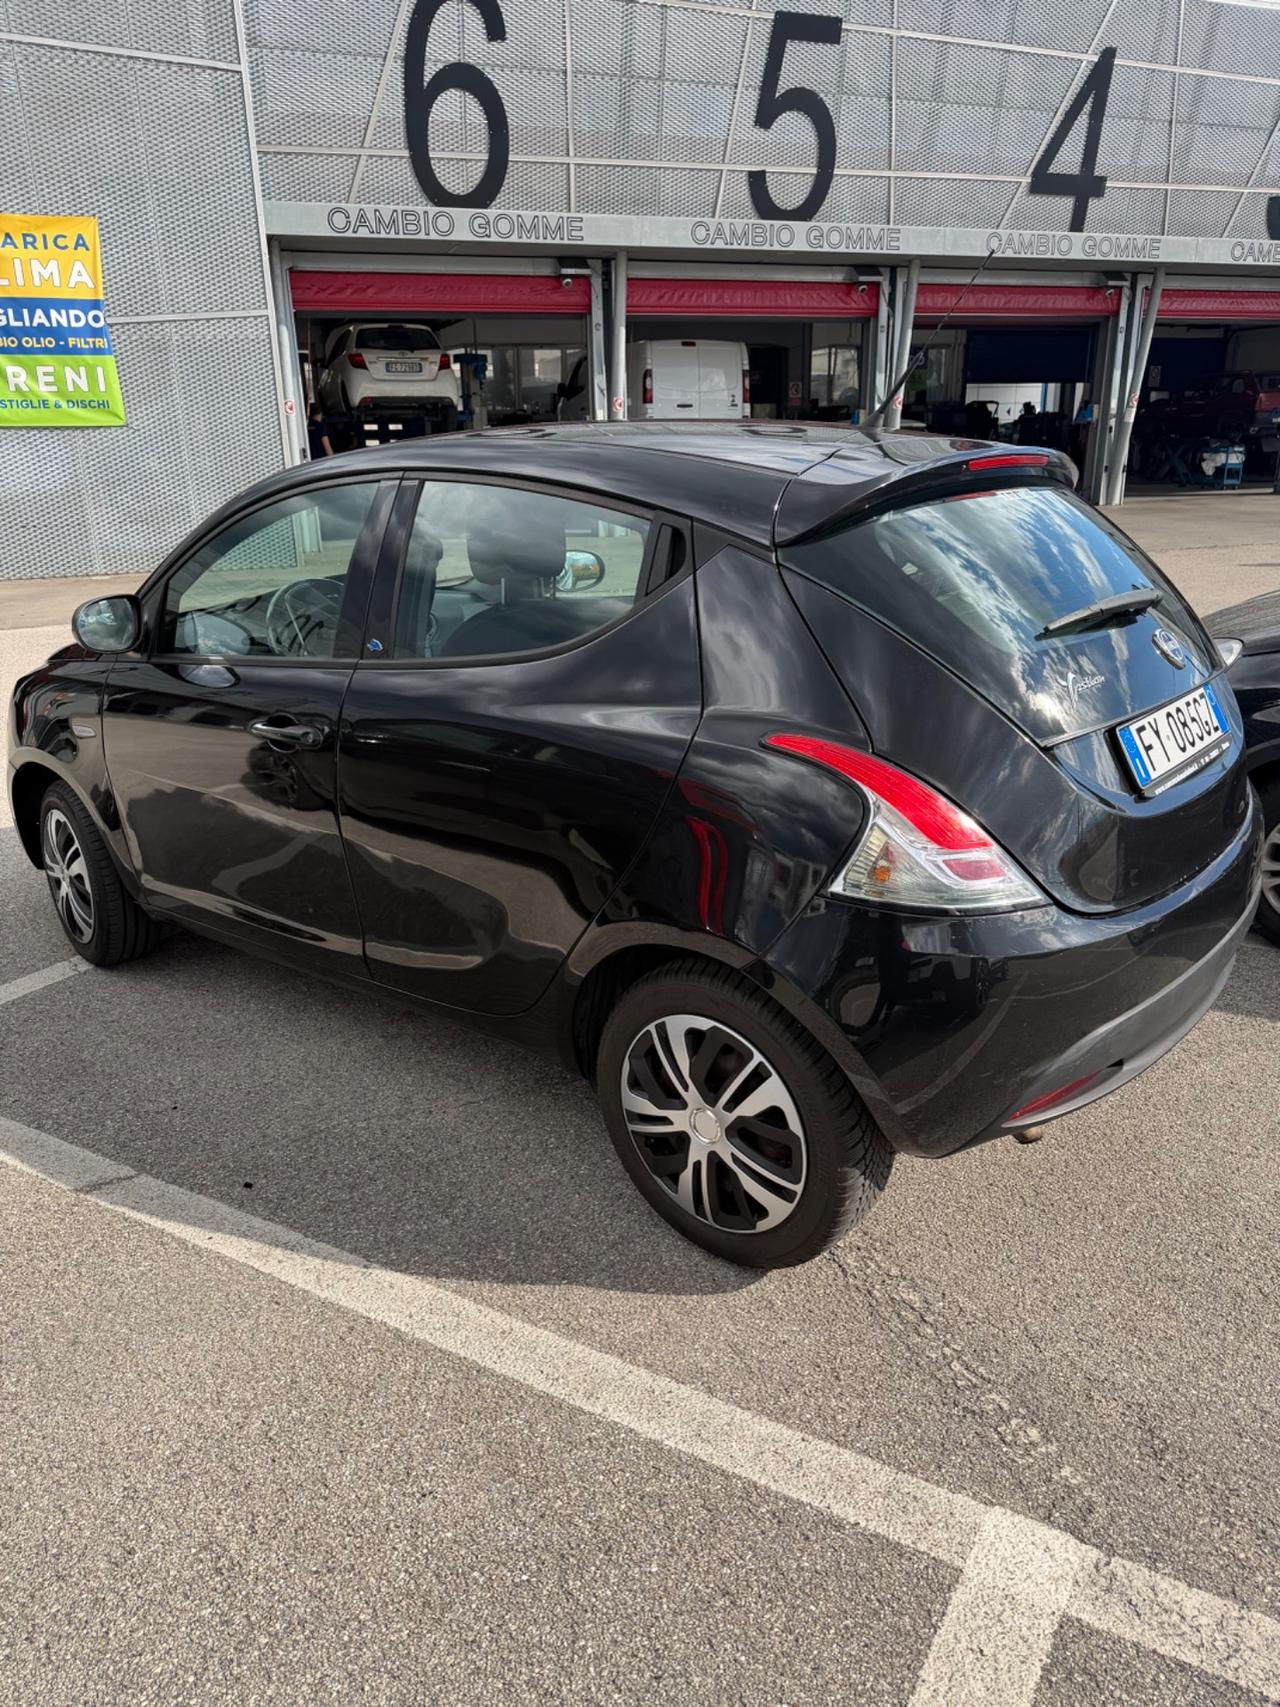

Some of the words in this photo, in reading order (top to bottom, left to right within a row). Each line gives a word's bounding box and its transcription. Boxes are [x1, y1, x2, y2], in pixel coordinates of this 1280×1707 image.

[405, 0, 509, 209] 6
[748, 11, 842, 221] 5
[1030, 47, 1117, 232] 4
[328, 207, 455, 236] CAMBIO
[469, 213, 584, 241] GOMME
[691, 221, 795, 247] CAMBIO
[806, 226, 901, 250] GOMME
[0, 232, 90, 251] ARICA
[986, 232, 1073, 256] CAMBIO
[1082, 236, 1162, 259] GOMME
[22, 337, 55, 348] OLIO
[68, 337, 108, 349] FILTRI
[5, 365, 106, 392] RENI
[54, 399, 62, 409] &
[67, 399, 110, 409] DISCHI
[1136, 717, 1170, 772] FY
